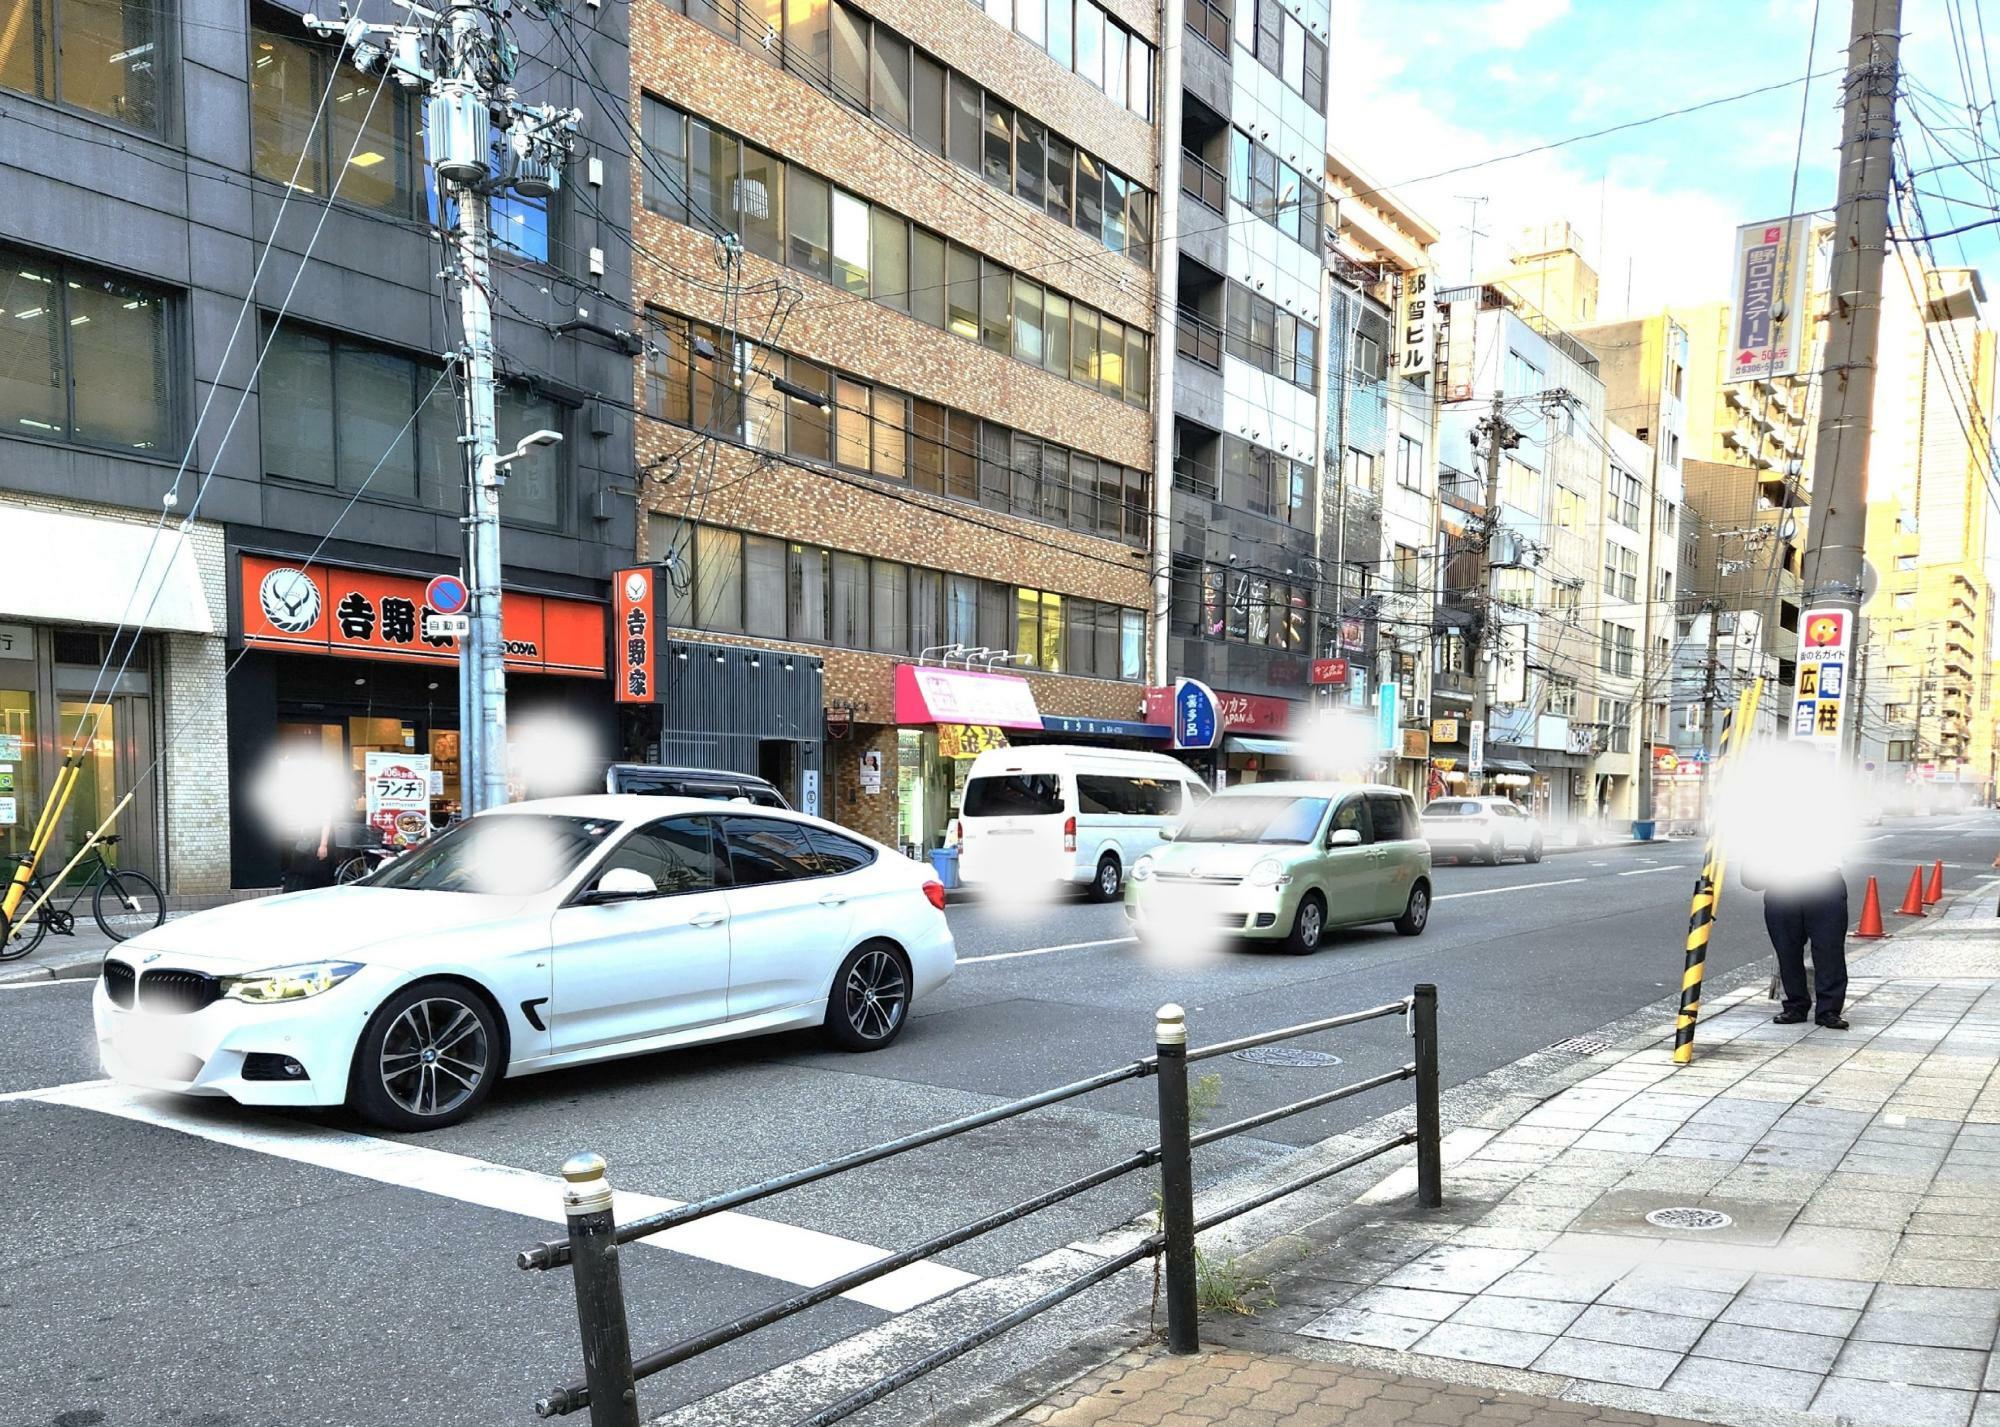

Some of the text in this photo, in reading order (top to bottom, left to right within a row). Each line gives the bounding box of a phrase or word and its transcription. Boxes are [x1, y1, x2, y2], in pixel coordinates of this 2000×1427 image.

[1745, 248, 1775, 347] 野口エステート
[429, 620, 467, 631] 自動車
[627, 606, 647, 697] 吉野家
[1220, 697, 1248, 714] ンカラ
[1819, 667, 1840, 731] 電柱
[377, 780, 417, 797] ランチ
